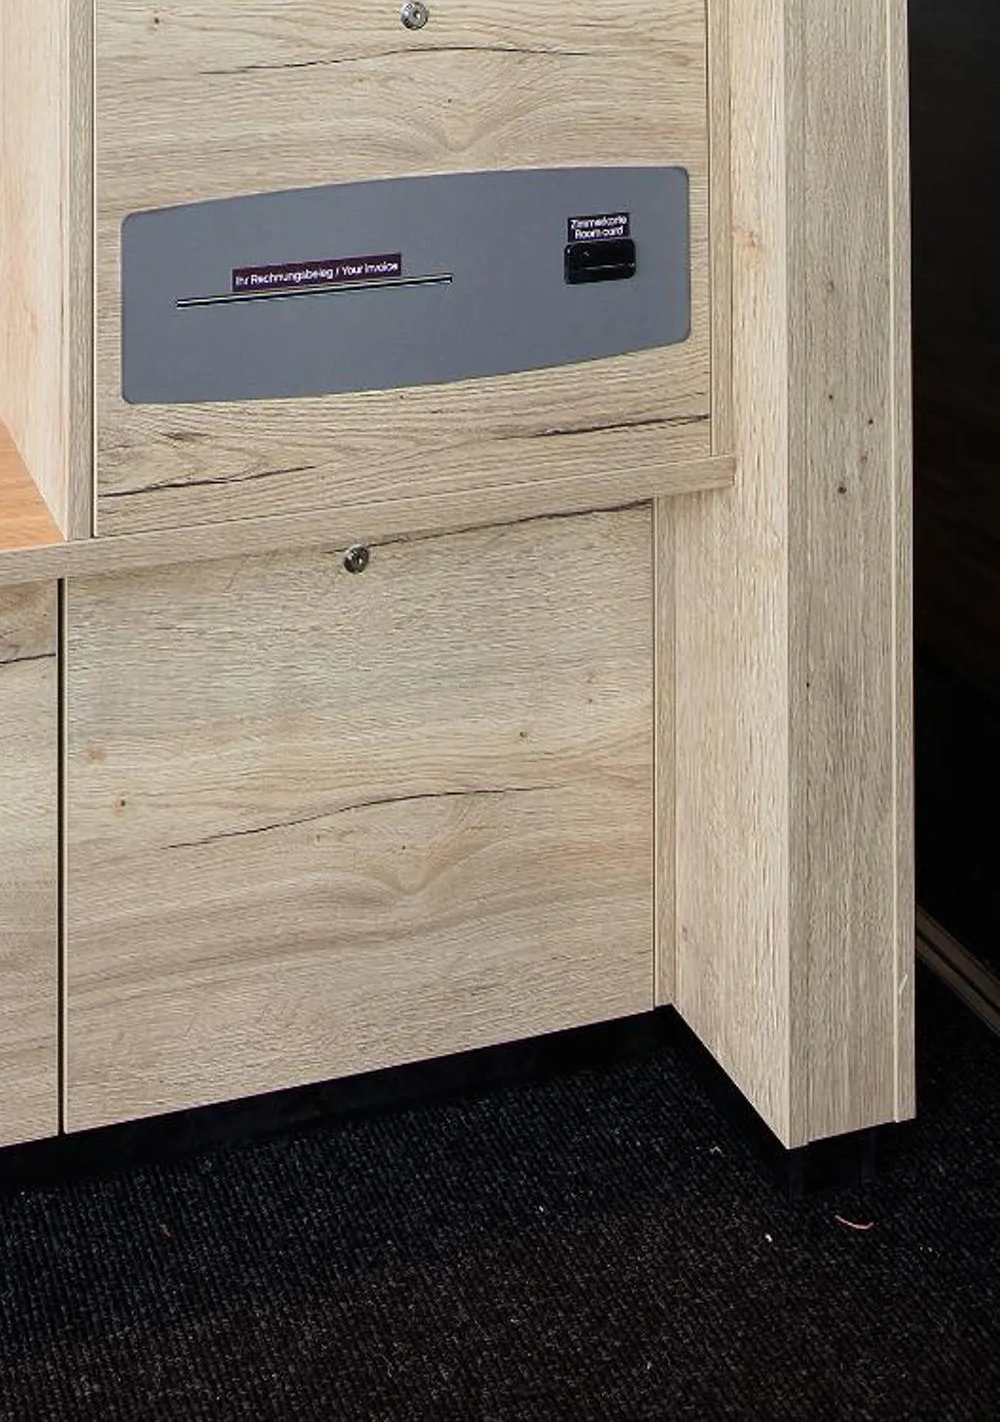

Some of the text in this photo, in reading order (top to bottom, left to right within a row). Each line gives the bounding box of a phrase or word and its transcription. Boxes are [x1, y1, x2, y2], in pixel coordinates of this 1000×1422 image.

[235, 276, 249, 285] Ihr
[251, 268, 333, 285] Rechnungsbeleg
[342, 265, 362, 276] Your
[365, 262, 398, 273] invoice
